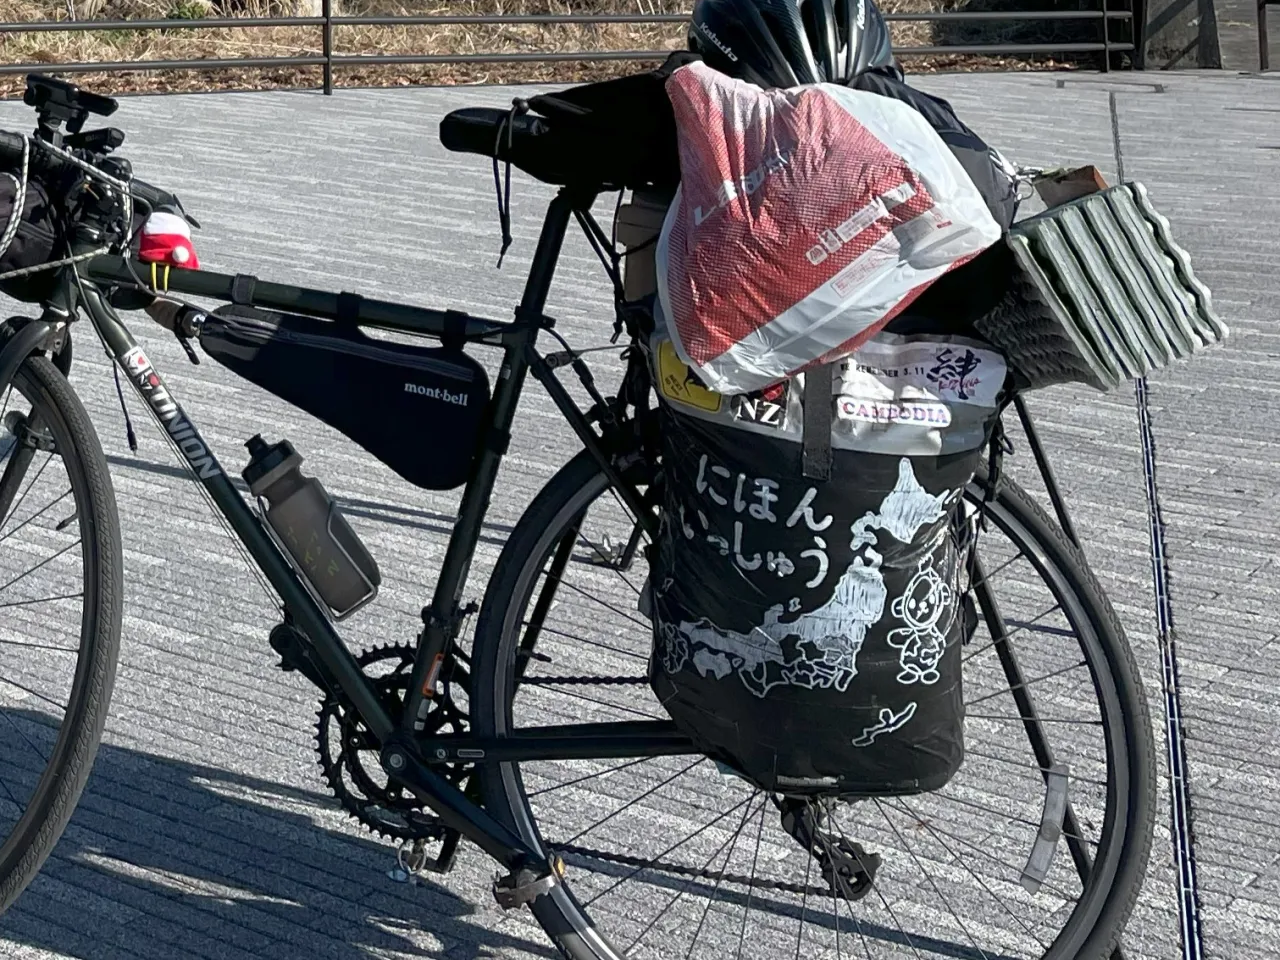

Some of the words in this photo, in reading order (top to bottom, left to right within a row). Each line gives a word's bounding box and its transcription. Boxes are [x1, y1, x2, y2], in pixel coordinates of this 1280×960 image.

[733, 397, 781, 426] NZ
[842, 401, 949, 424] CAMBODIA
[696, 454, 833, 531] にほん
[679, 503, 829, 588] いっしゅう
